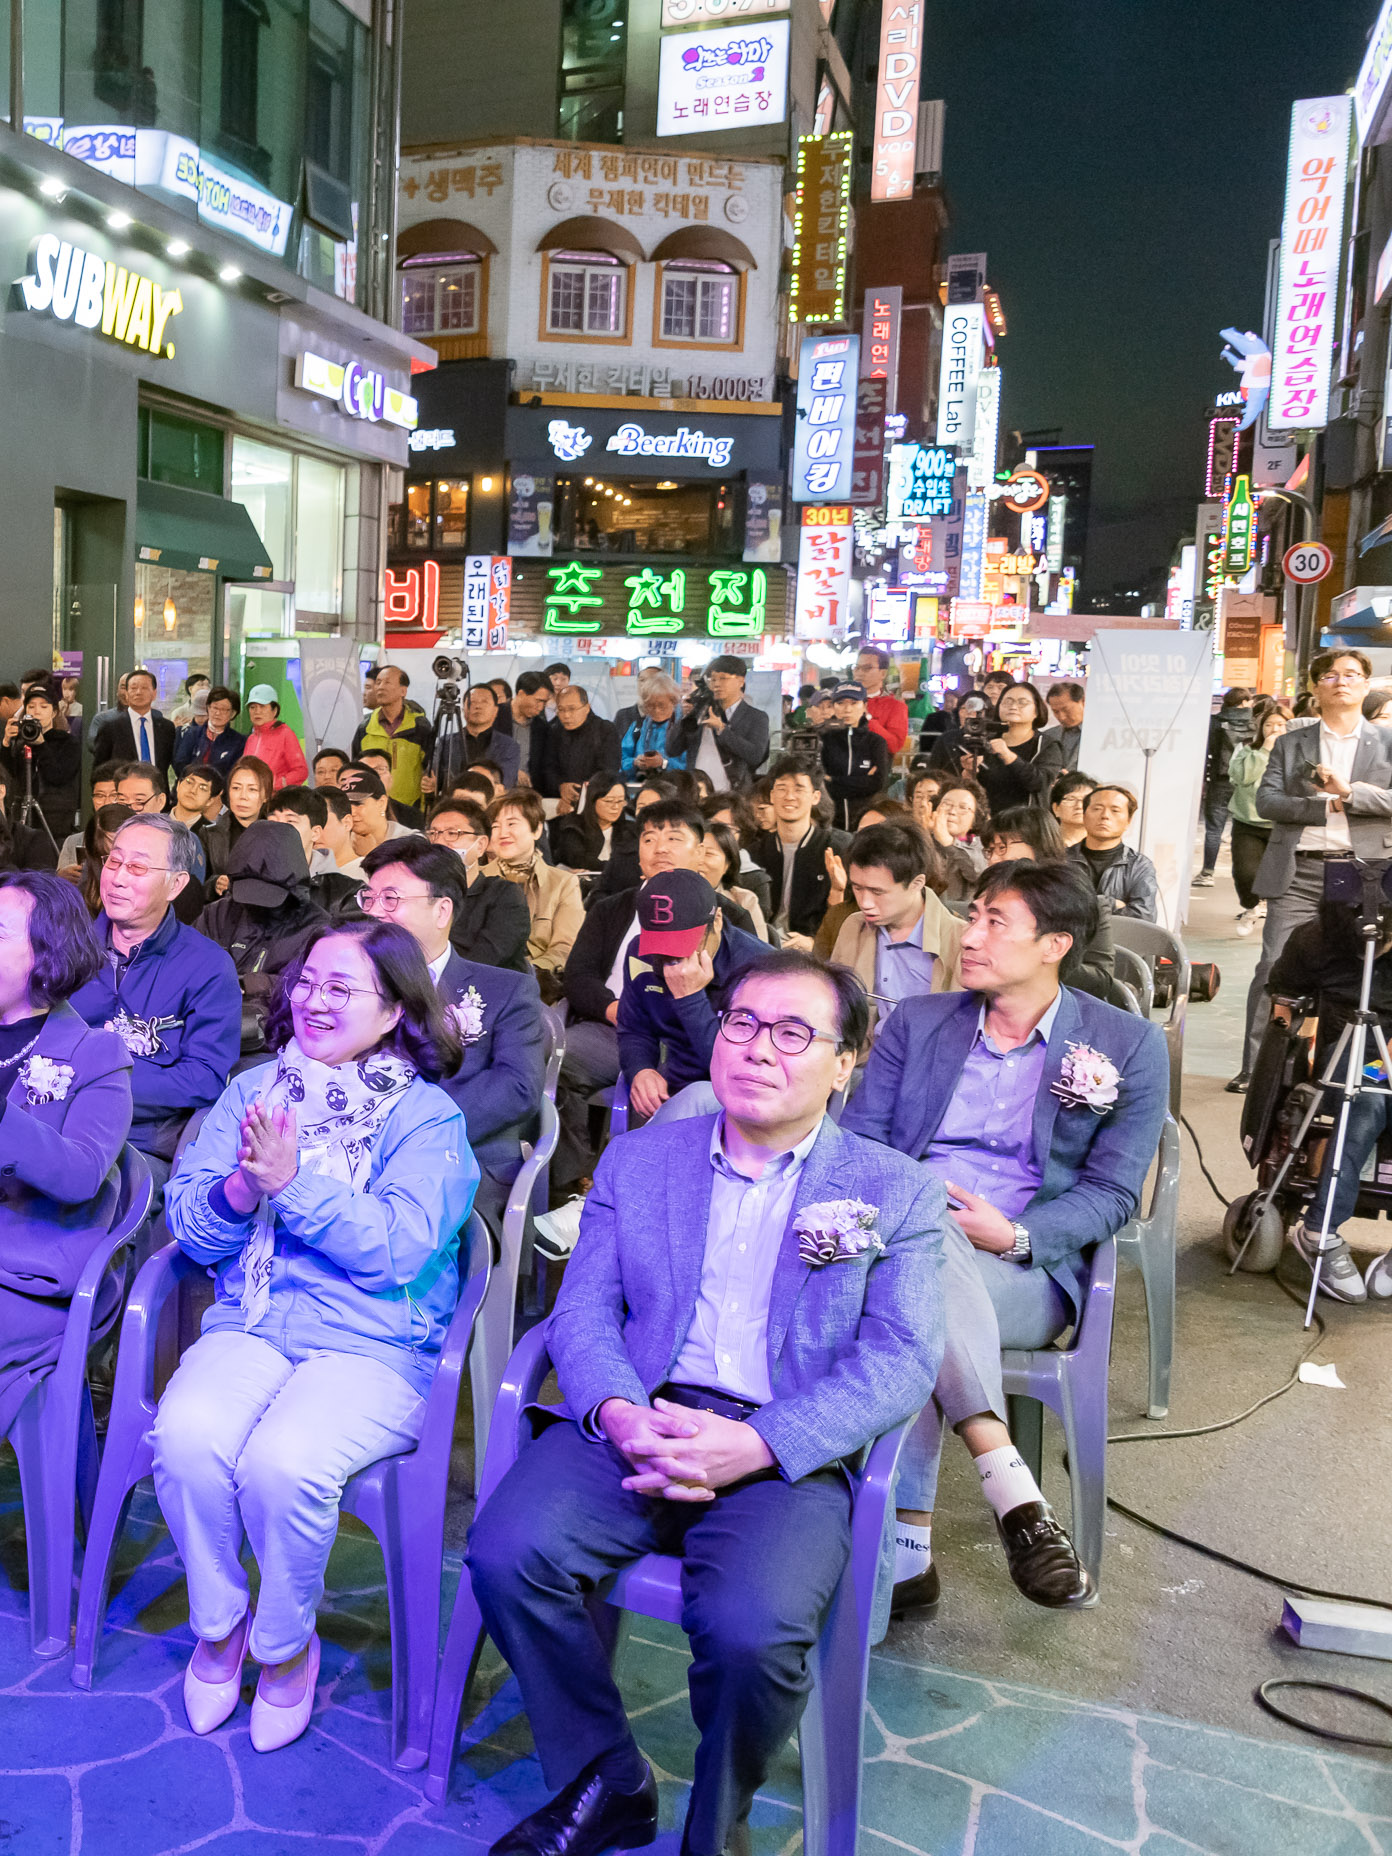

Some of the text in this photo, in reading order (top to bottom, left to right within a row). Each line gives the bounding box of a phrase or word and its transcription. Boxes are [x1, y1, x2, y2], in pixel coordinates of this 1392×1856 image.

[673, 91, 773, 119] 노래연습장
[948, 317, 968, 394] COFFEE
[1280, 260, 1326, 419] 노래연습장
[620, 424, 734, 466] Beerking
[903, 498, 952, 515] DRAFT
[804, 532, 847, 626] 닭갈비
[1294, 553, 1321, 572] 30
[466, 561, 486, 647] 오래된집
[545, 561, 768, 636] 춘천집
[650, 894, 675, 924] B
